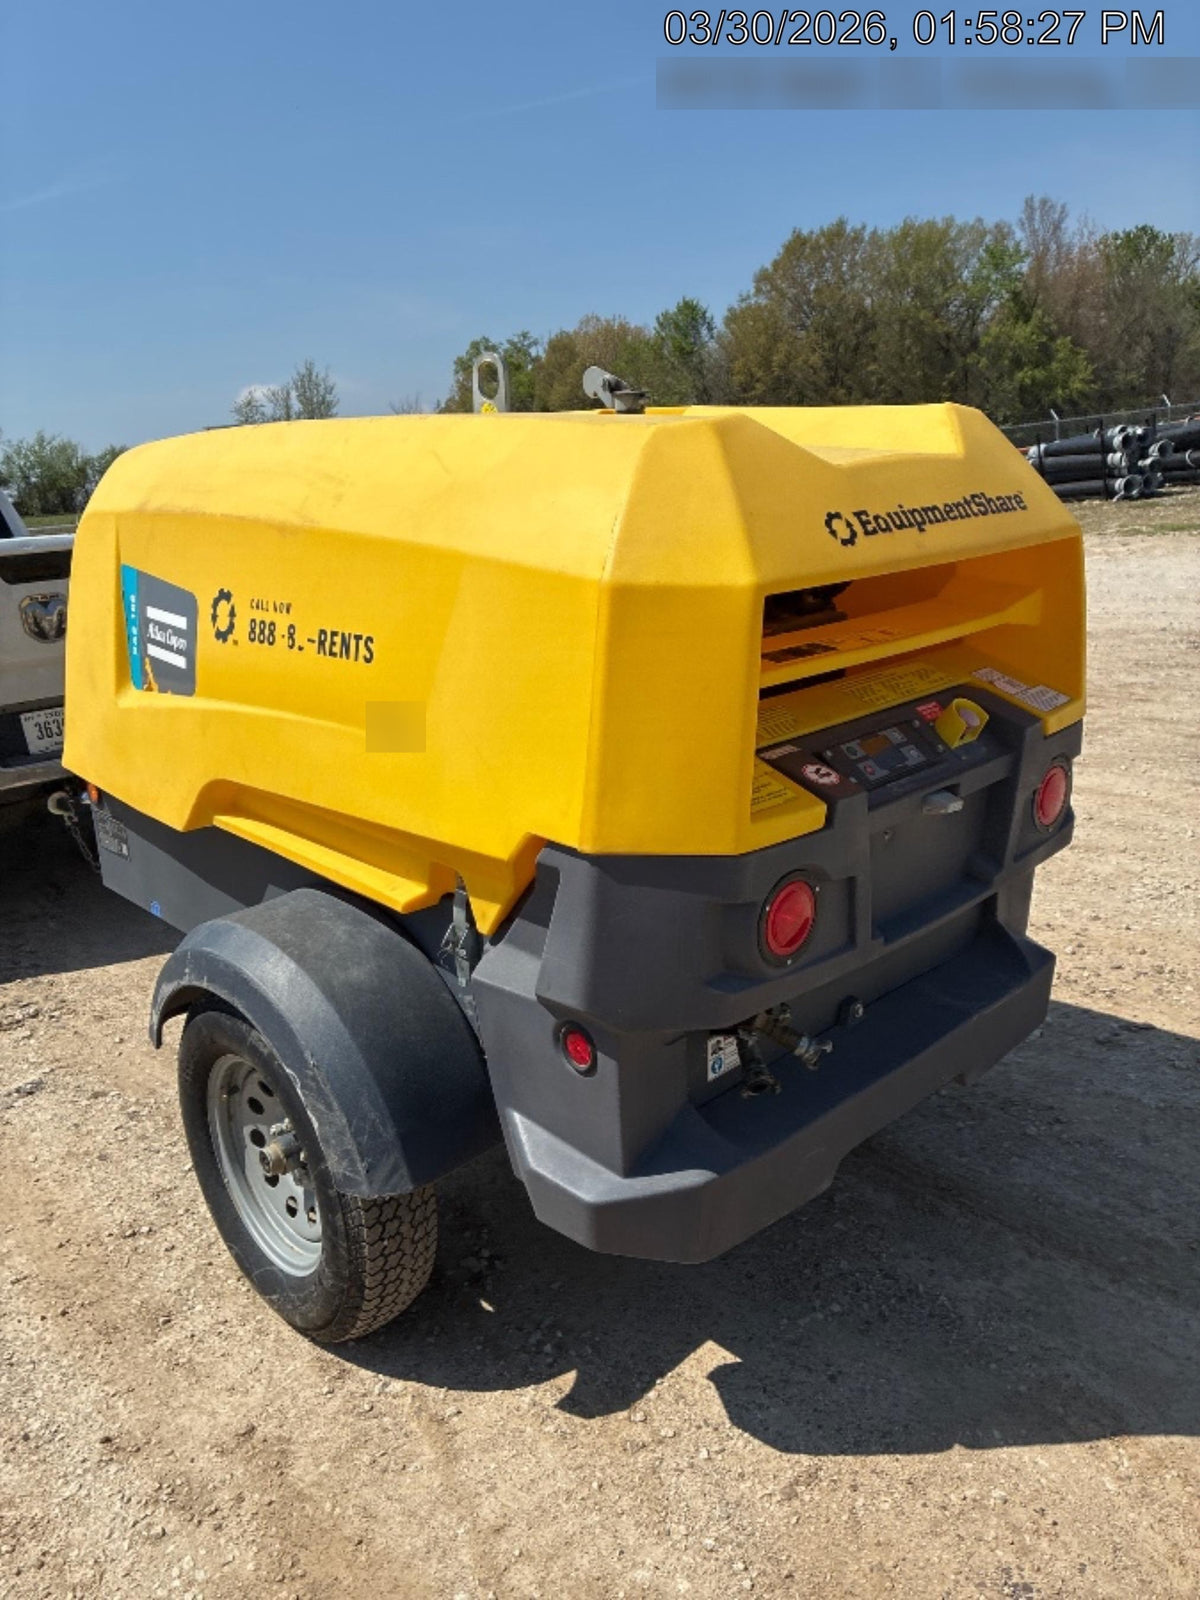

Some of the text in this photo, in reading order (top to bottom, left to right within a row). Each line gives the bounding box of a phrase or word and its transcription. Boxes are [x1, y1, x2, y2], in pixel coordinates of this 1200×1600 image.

[852, 491, 1027, 533] EquipmentShare
[250, 598, 292, 614] CALL NOW
[34, 718, 64, 741] 363
